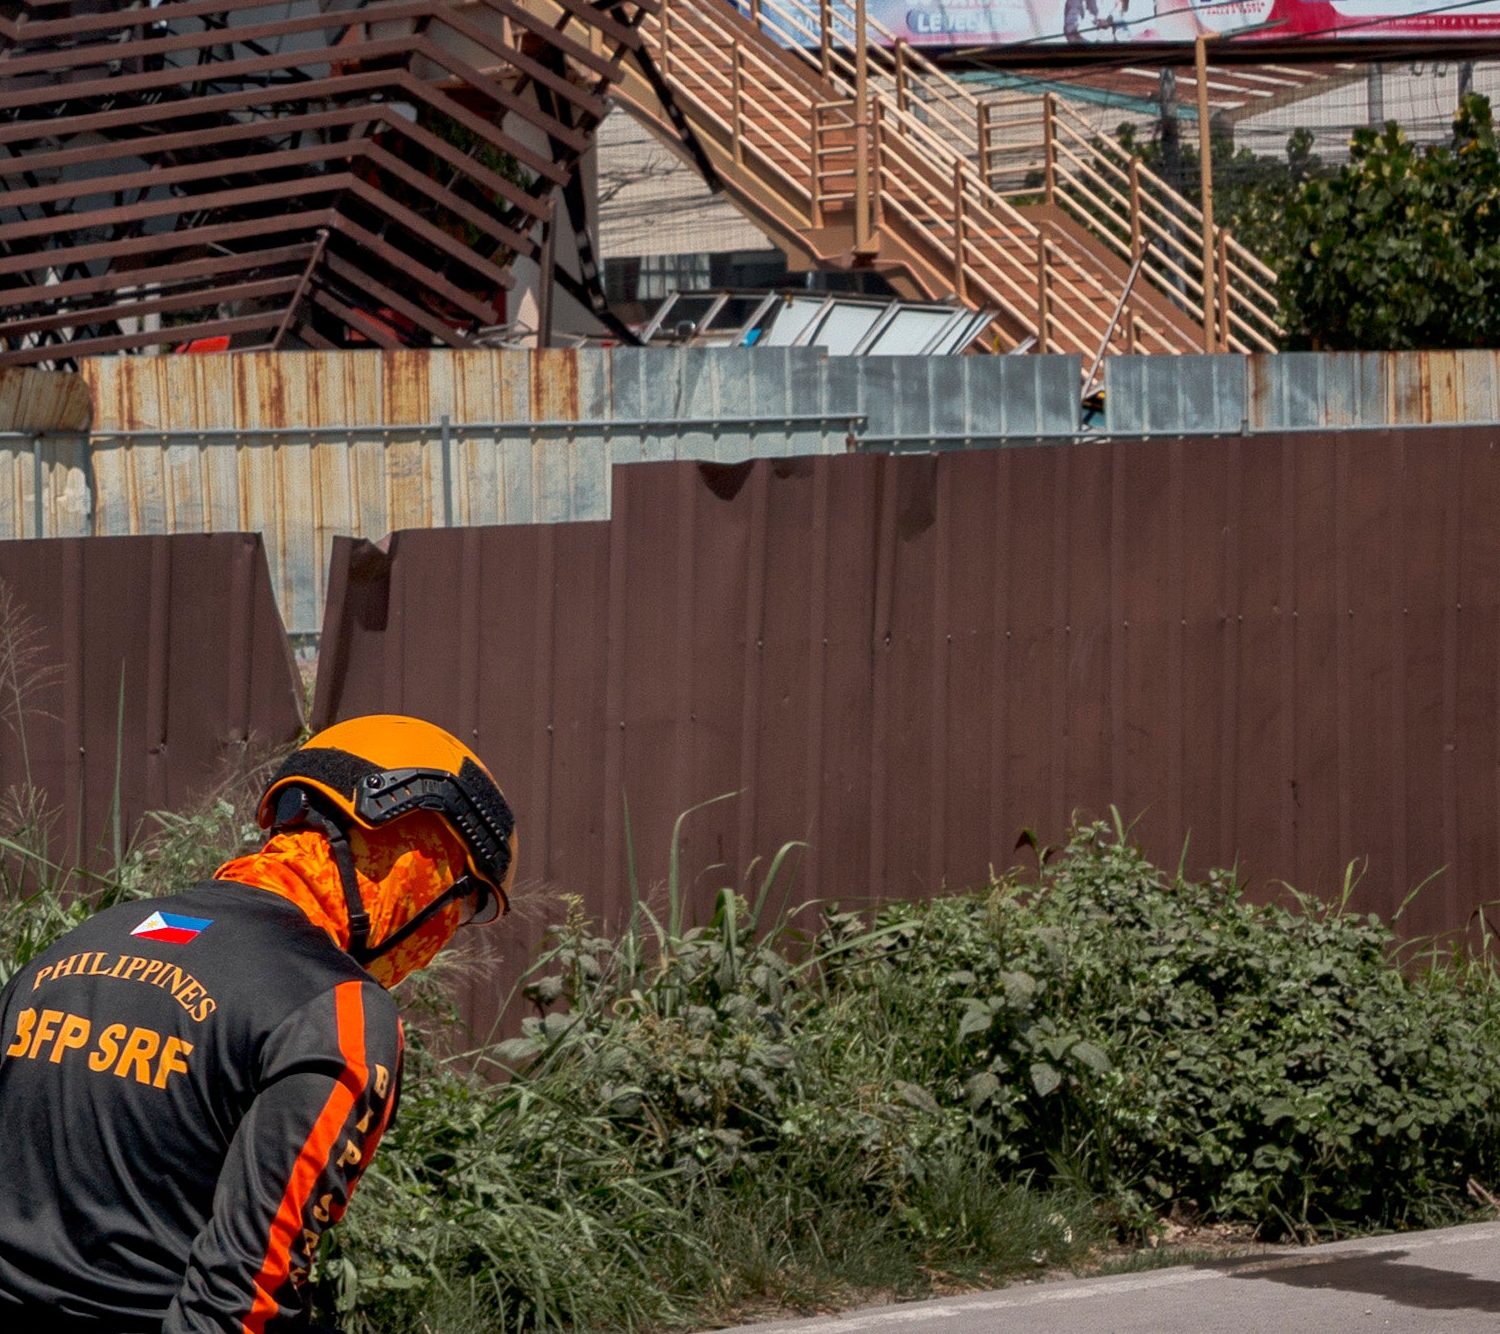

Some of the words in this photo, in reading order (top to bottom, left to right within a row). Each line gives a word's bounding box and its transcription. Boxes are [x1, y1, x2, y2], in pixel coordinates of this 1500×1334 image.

[31, 951, 218, 1023] PHILIPPINES
[6, 1007, 92, 1064] BFP
[88, 1023, 195, 1090] SRF
